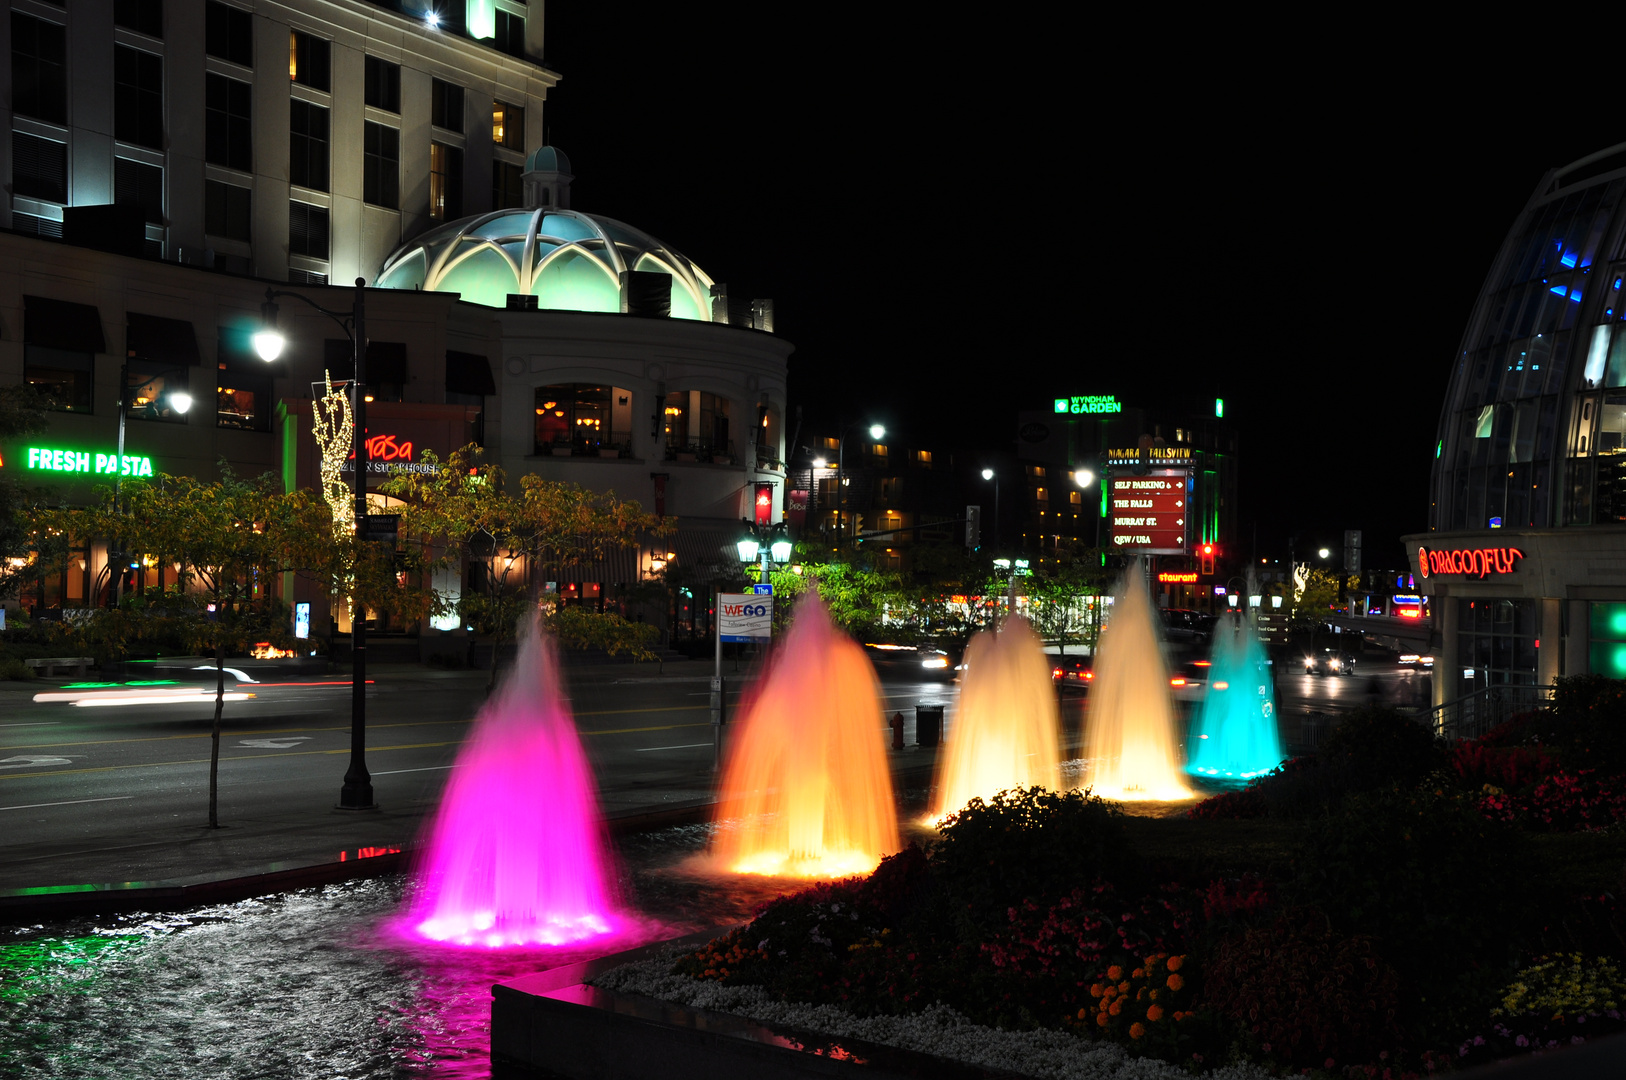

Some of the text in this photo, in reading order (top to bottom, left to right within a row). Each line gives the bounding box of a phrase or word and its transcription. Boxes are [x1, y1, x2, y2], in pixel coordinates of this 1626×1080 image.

[1070, 402, 1122, 414] GARDEN
[1108, 447, 1191, 459] NIAGARA FALLSVIEW
[28, 447, 90, 473] FRESH
[95, 453, 153, 478] PASTA
[1114, 481, 1165, 489] SELF PARKING
[1114, 500, 1153, 508] THE FALLS
[1114, 518, 1157, 526] MURRAY ST.
[1114, 535, 1132, 546] QEW
[1136, 536, 1151, 544] USA
[1429, 548, 1523, 579] DRAGONFLY
[757, 587, 769, 595] The
[724, 604, 766, 617] WEGO
